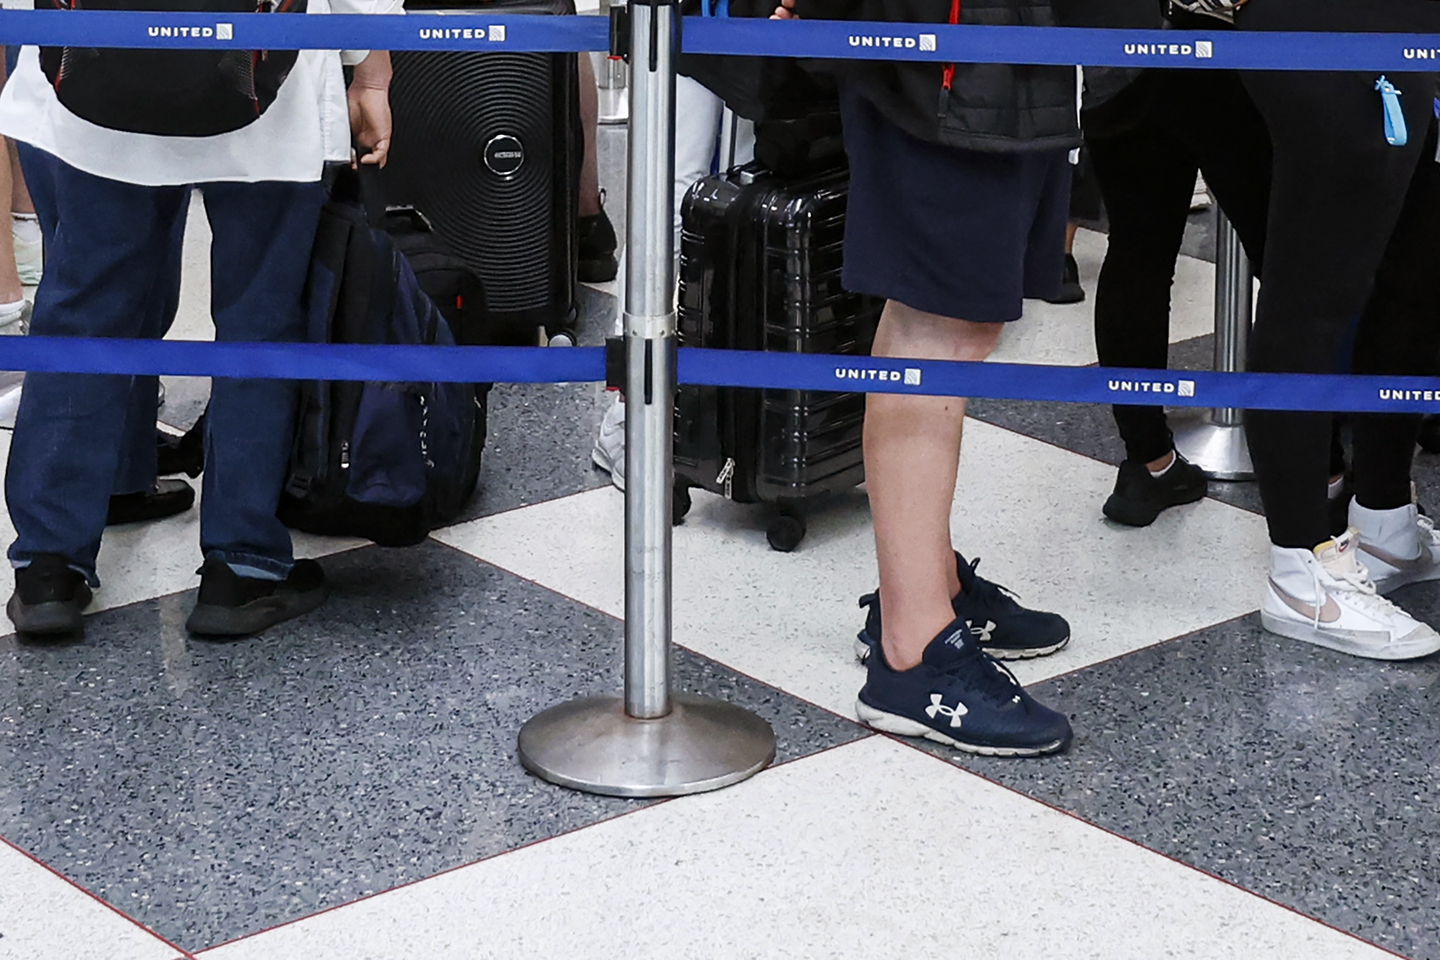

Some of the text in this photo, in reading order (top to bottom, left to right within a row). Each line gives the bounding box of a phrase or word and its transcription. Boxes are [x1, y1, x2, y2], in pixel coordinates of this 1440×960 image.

[148, 26, 213, 38] UNITED
[419, 28, 486, 39] UNITED
[848, 35, 916, 48] UNITED
[1124, 44, 1192, 55] UNITED
[835, 368, 901, 381] UNITED
[1108, 380, 1175, 393] UNITED
